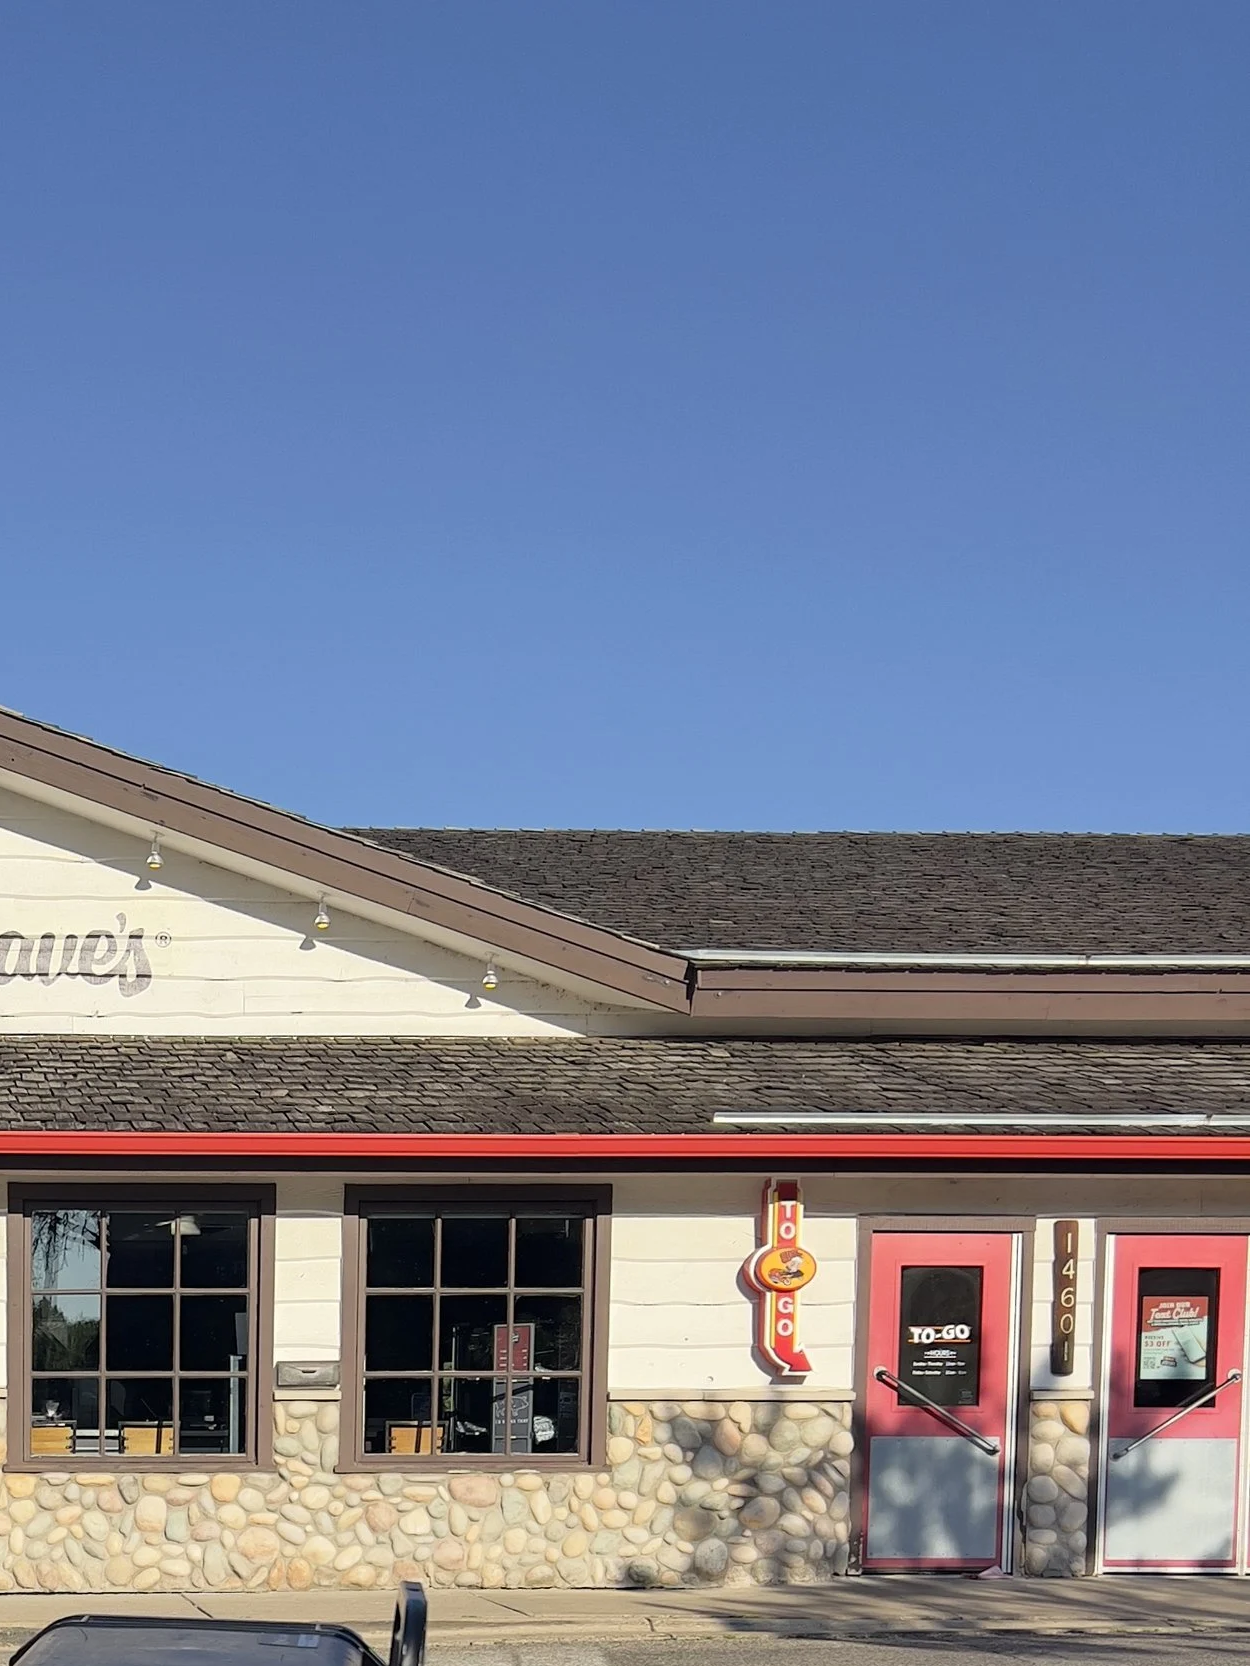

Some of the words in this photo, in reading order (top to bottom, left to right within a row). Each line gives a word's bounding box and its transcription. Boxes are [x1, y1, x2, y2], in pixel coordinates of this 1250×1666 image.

[779, 1201, 797, 1240] TO
[776, 1297, 794, 1336] GO
[1150, 1308, 1172, 1320] Text
[1172, 1306, 1200, 1319] Club!
[909, 1324, 971, 1344] TO-GO
